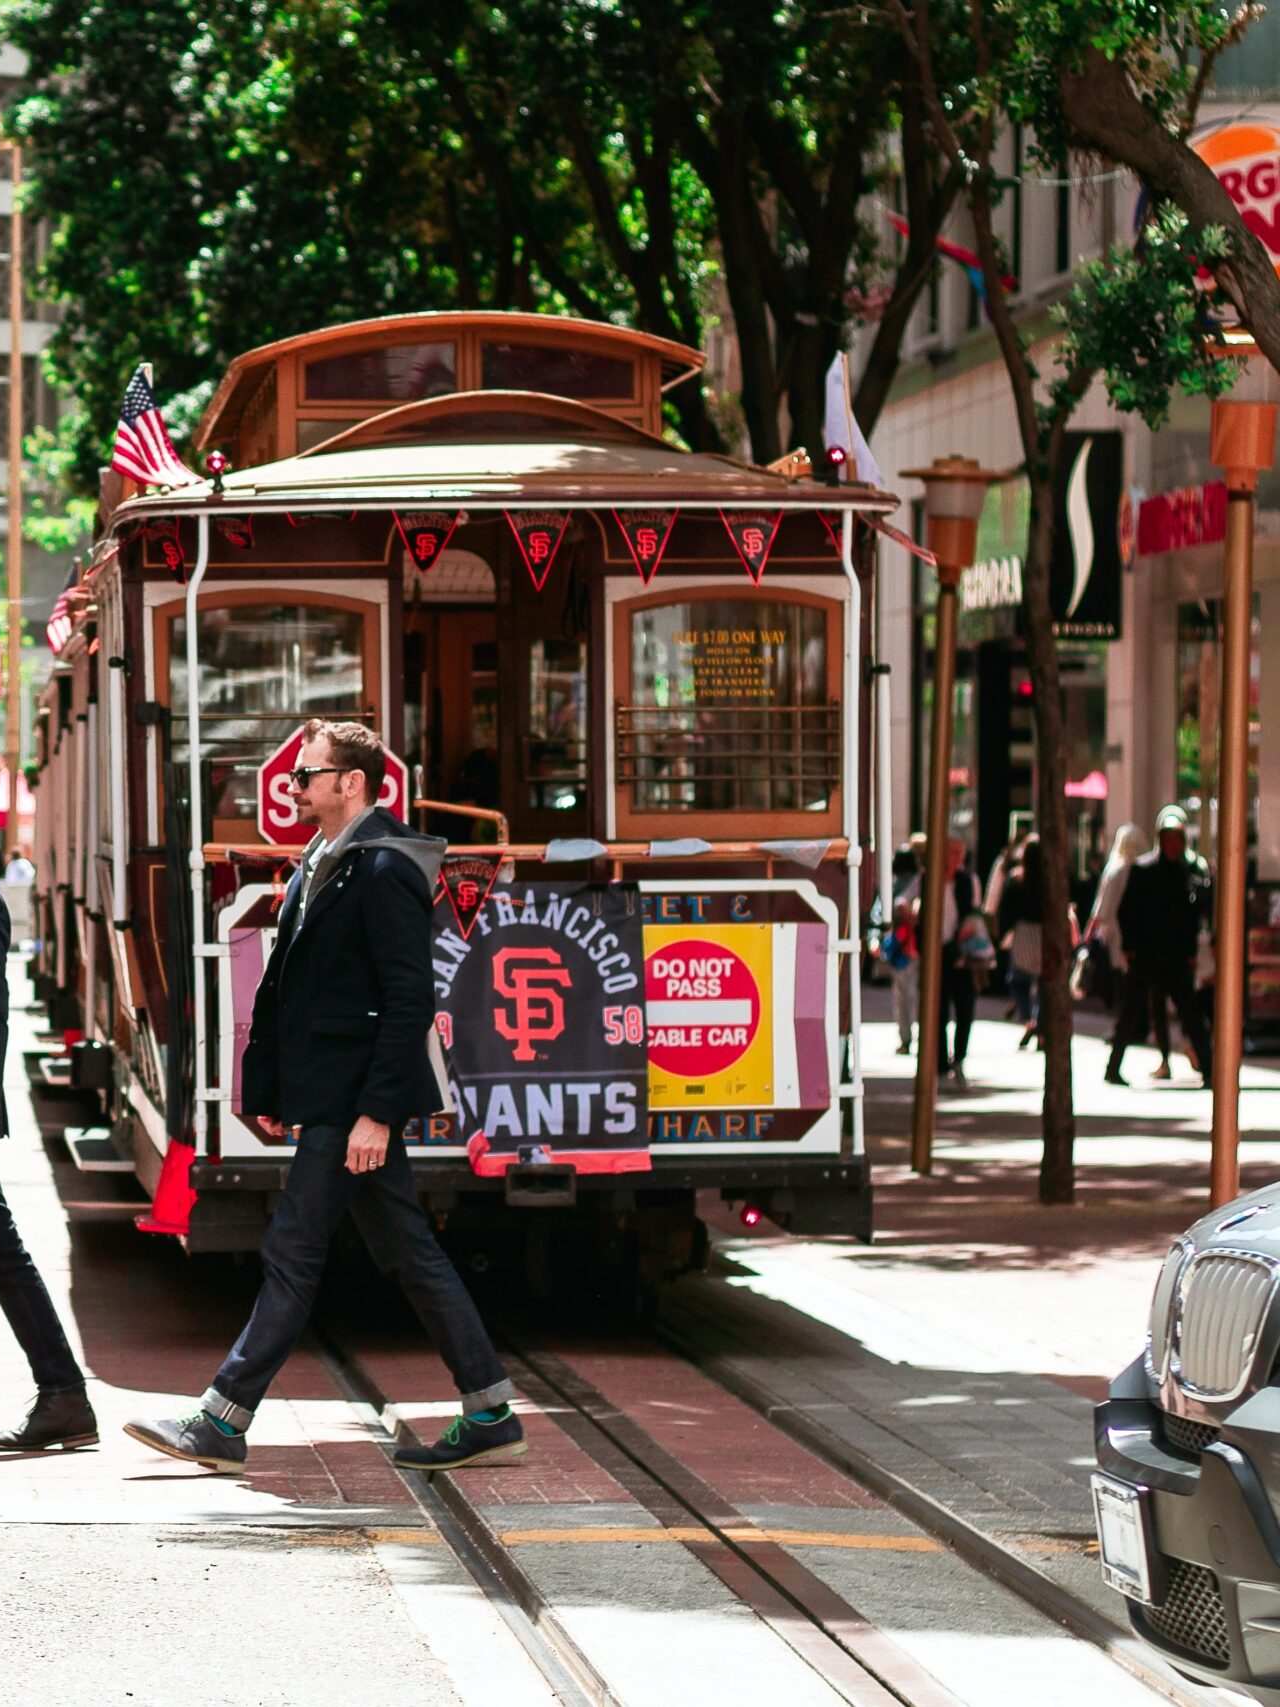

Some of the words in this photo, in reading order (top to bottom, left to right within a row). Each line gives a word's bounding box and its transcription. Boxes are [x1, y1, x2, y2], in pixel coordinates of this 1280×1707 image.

[732, 631, 757, 644] ONE
[760, 631, 786, 644] WAY
[268, 773, 399, 828] SP
[652, 958, 686, 979] DO
[689, 957, 735, 978] NOT
[666, 978, 722, 998] PASS
[492, 947, 573, 1061] SF
[434, 1011, 453, 1050] 9
[603, 1004, 644, 1046] 58
[707, 1027, 748, 1047] CAR
[647, 1112, 776, 1142] HARF
